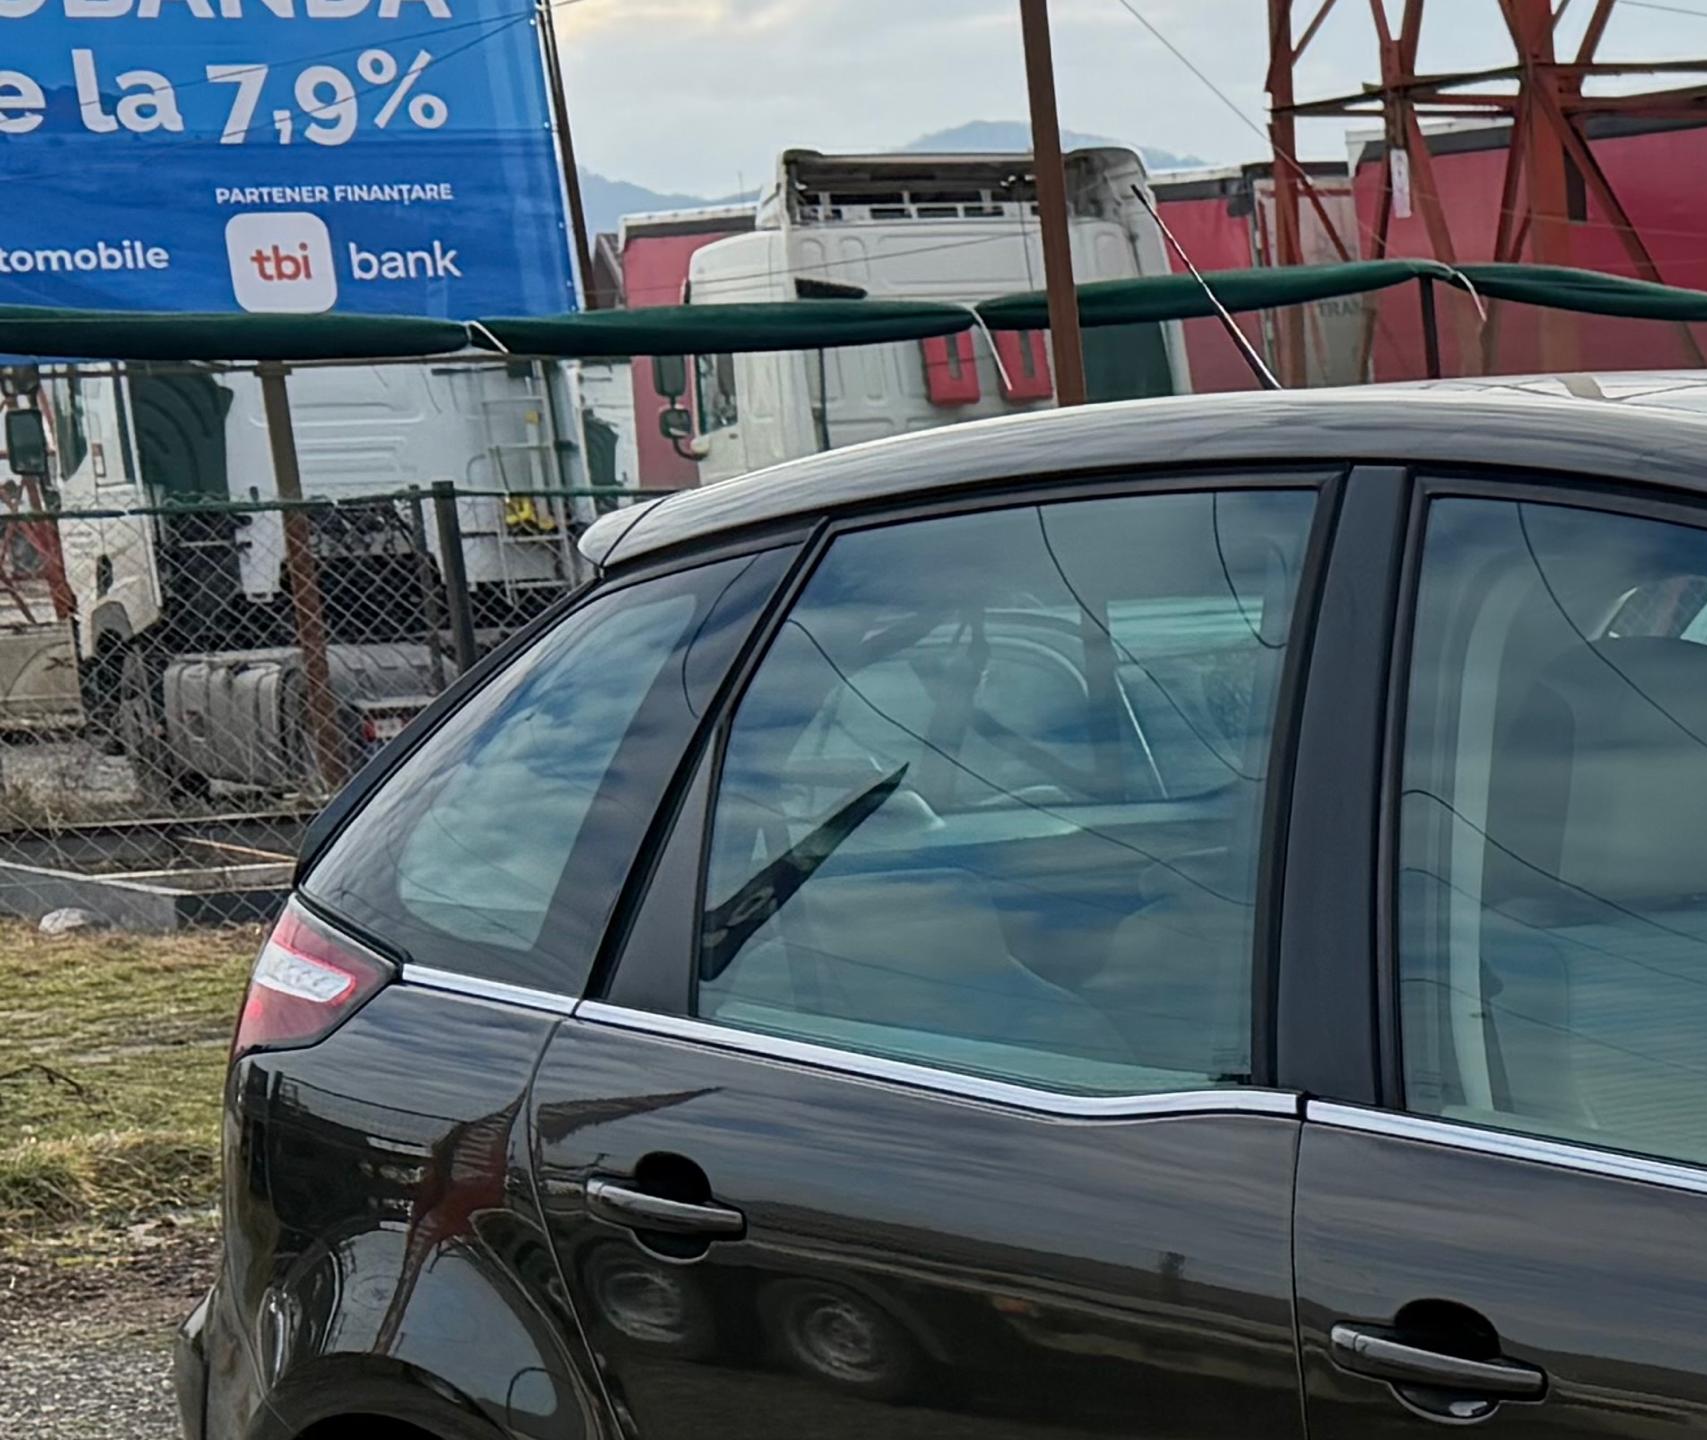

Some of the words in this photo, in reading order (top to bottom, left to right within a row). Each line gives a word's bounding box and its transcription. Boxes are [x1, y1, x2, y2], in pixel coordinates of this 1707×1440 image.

[71, 49, 185, 134] la
[205, 49, 449, 146] 7,9%
[215, 186, 330, 205] PARTENER
[250, 242, 313, 282] tbi
[348, 240, 462, 281] bank
